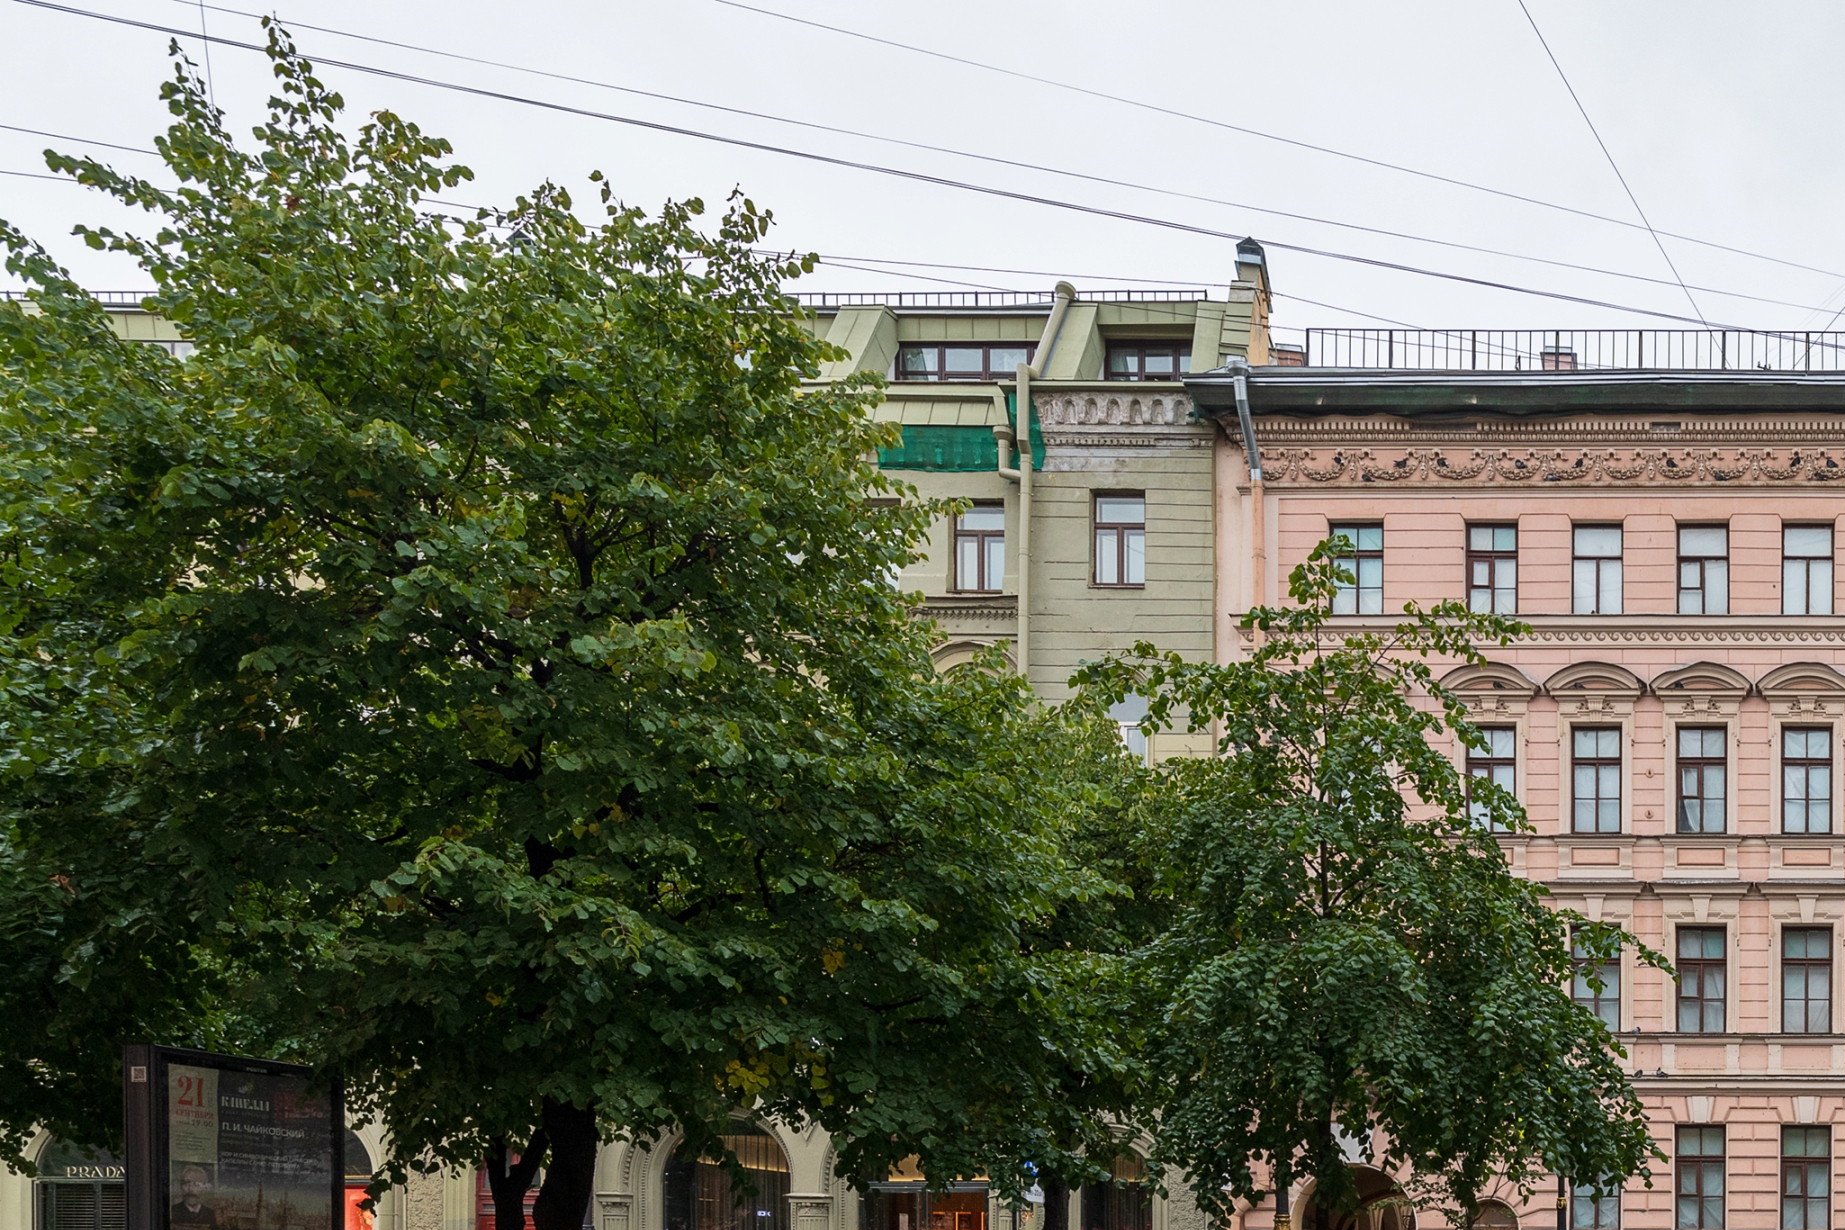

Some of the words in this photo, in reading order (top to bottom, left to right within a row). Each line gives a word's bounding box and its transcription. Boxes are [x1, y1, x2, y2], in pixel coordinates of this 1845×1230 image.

[178, 1075, 205, 1107] 21
[191, 1119, 214, 1128] 19.00
[222, 1121, 232, 1131] П.
[233, 1123, 243, 1133] И.
[243, 1124, 306, 1139] ЧАЙКОВСКИЙ
[66, 1166, 126, 1178] PRADA
